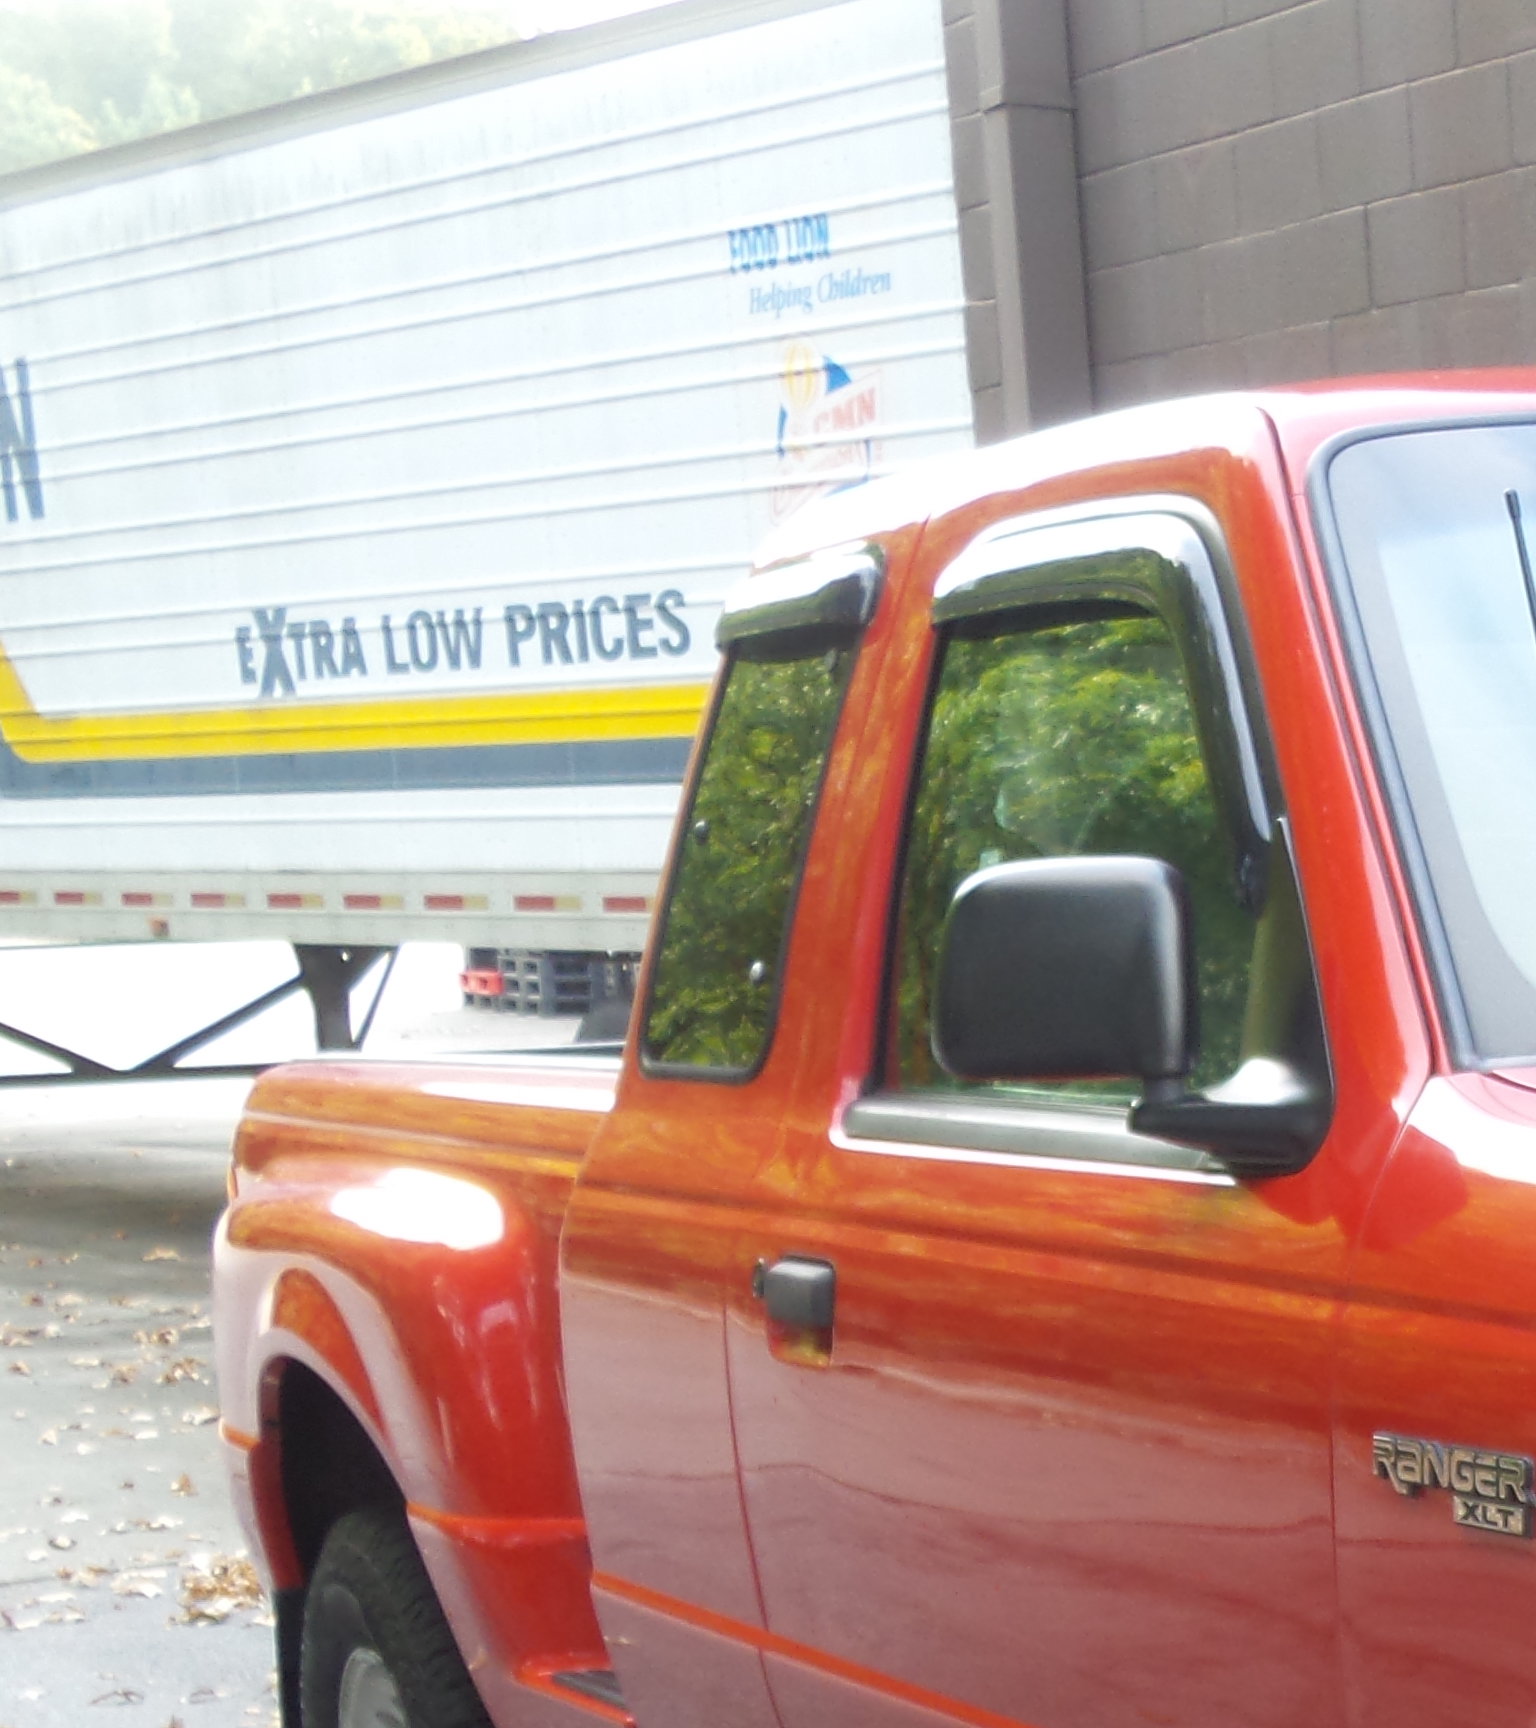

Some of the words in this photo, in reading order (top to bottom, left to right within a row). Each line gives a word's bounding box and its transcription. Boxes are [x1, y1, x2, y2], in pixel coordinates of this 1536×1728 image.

[749, 278, 813, 319] Helping
[817, 266, 892, 304] Children
[380, 606, 484, 676] LOW
[503, 589, 692, 668] PRICES
[1461, 1501, 1514, 1528] XLT
